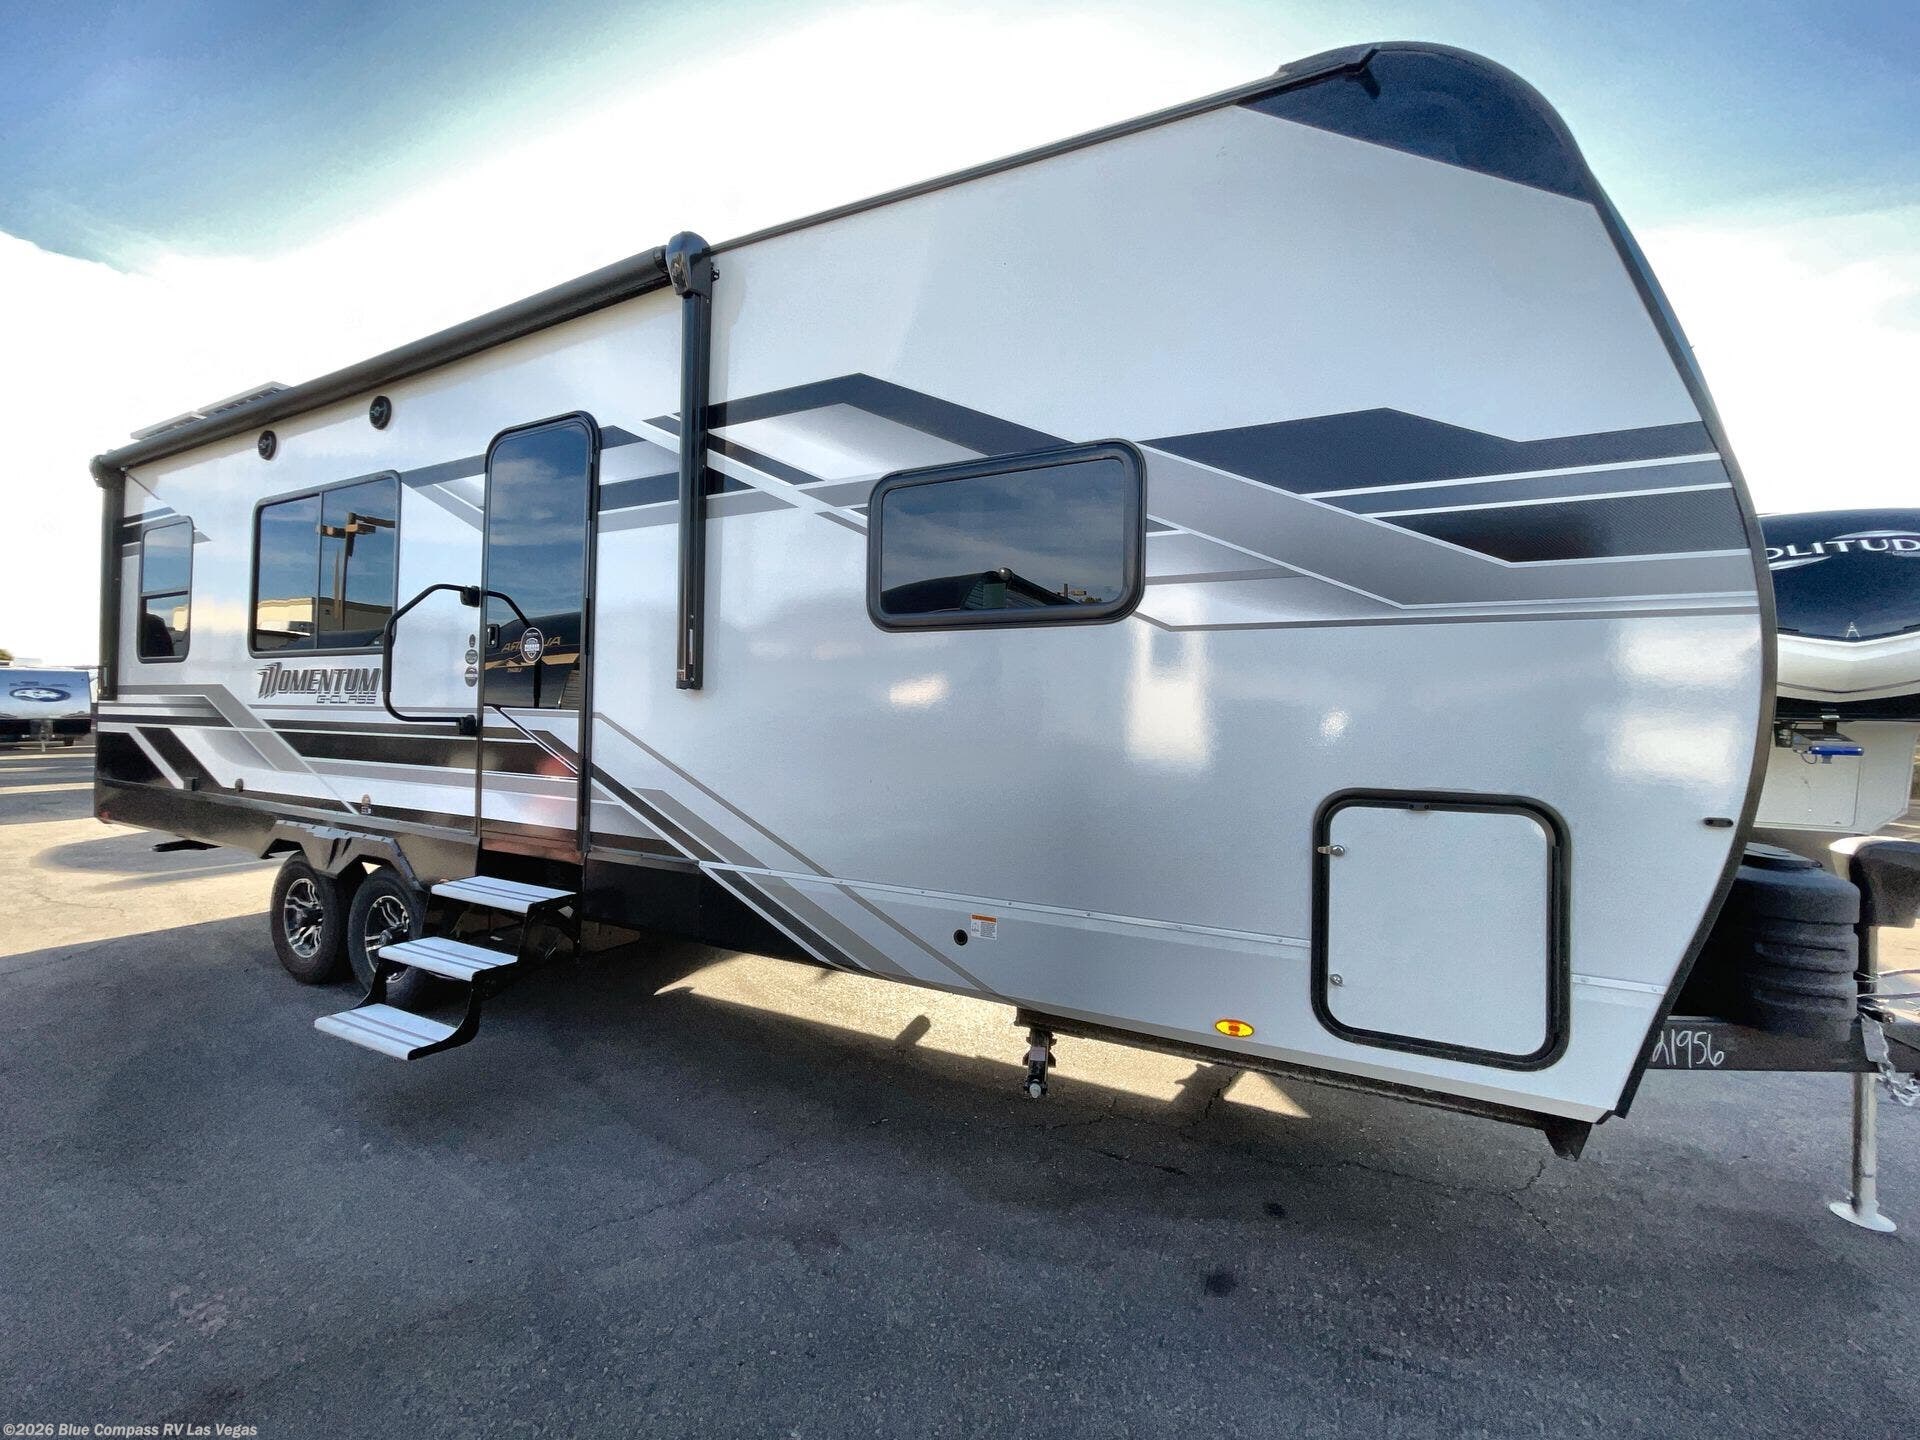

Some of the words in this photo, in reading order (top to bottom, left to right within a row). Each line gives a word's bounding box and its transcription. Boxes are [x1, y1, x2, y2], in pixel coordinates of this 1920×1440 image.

[257, 661, 382, 699] MOMENTUM
[316, 695, 377, 704] G-CLASS
[1652, 1028, 1725, 1068] 21956
